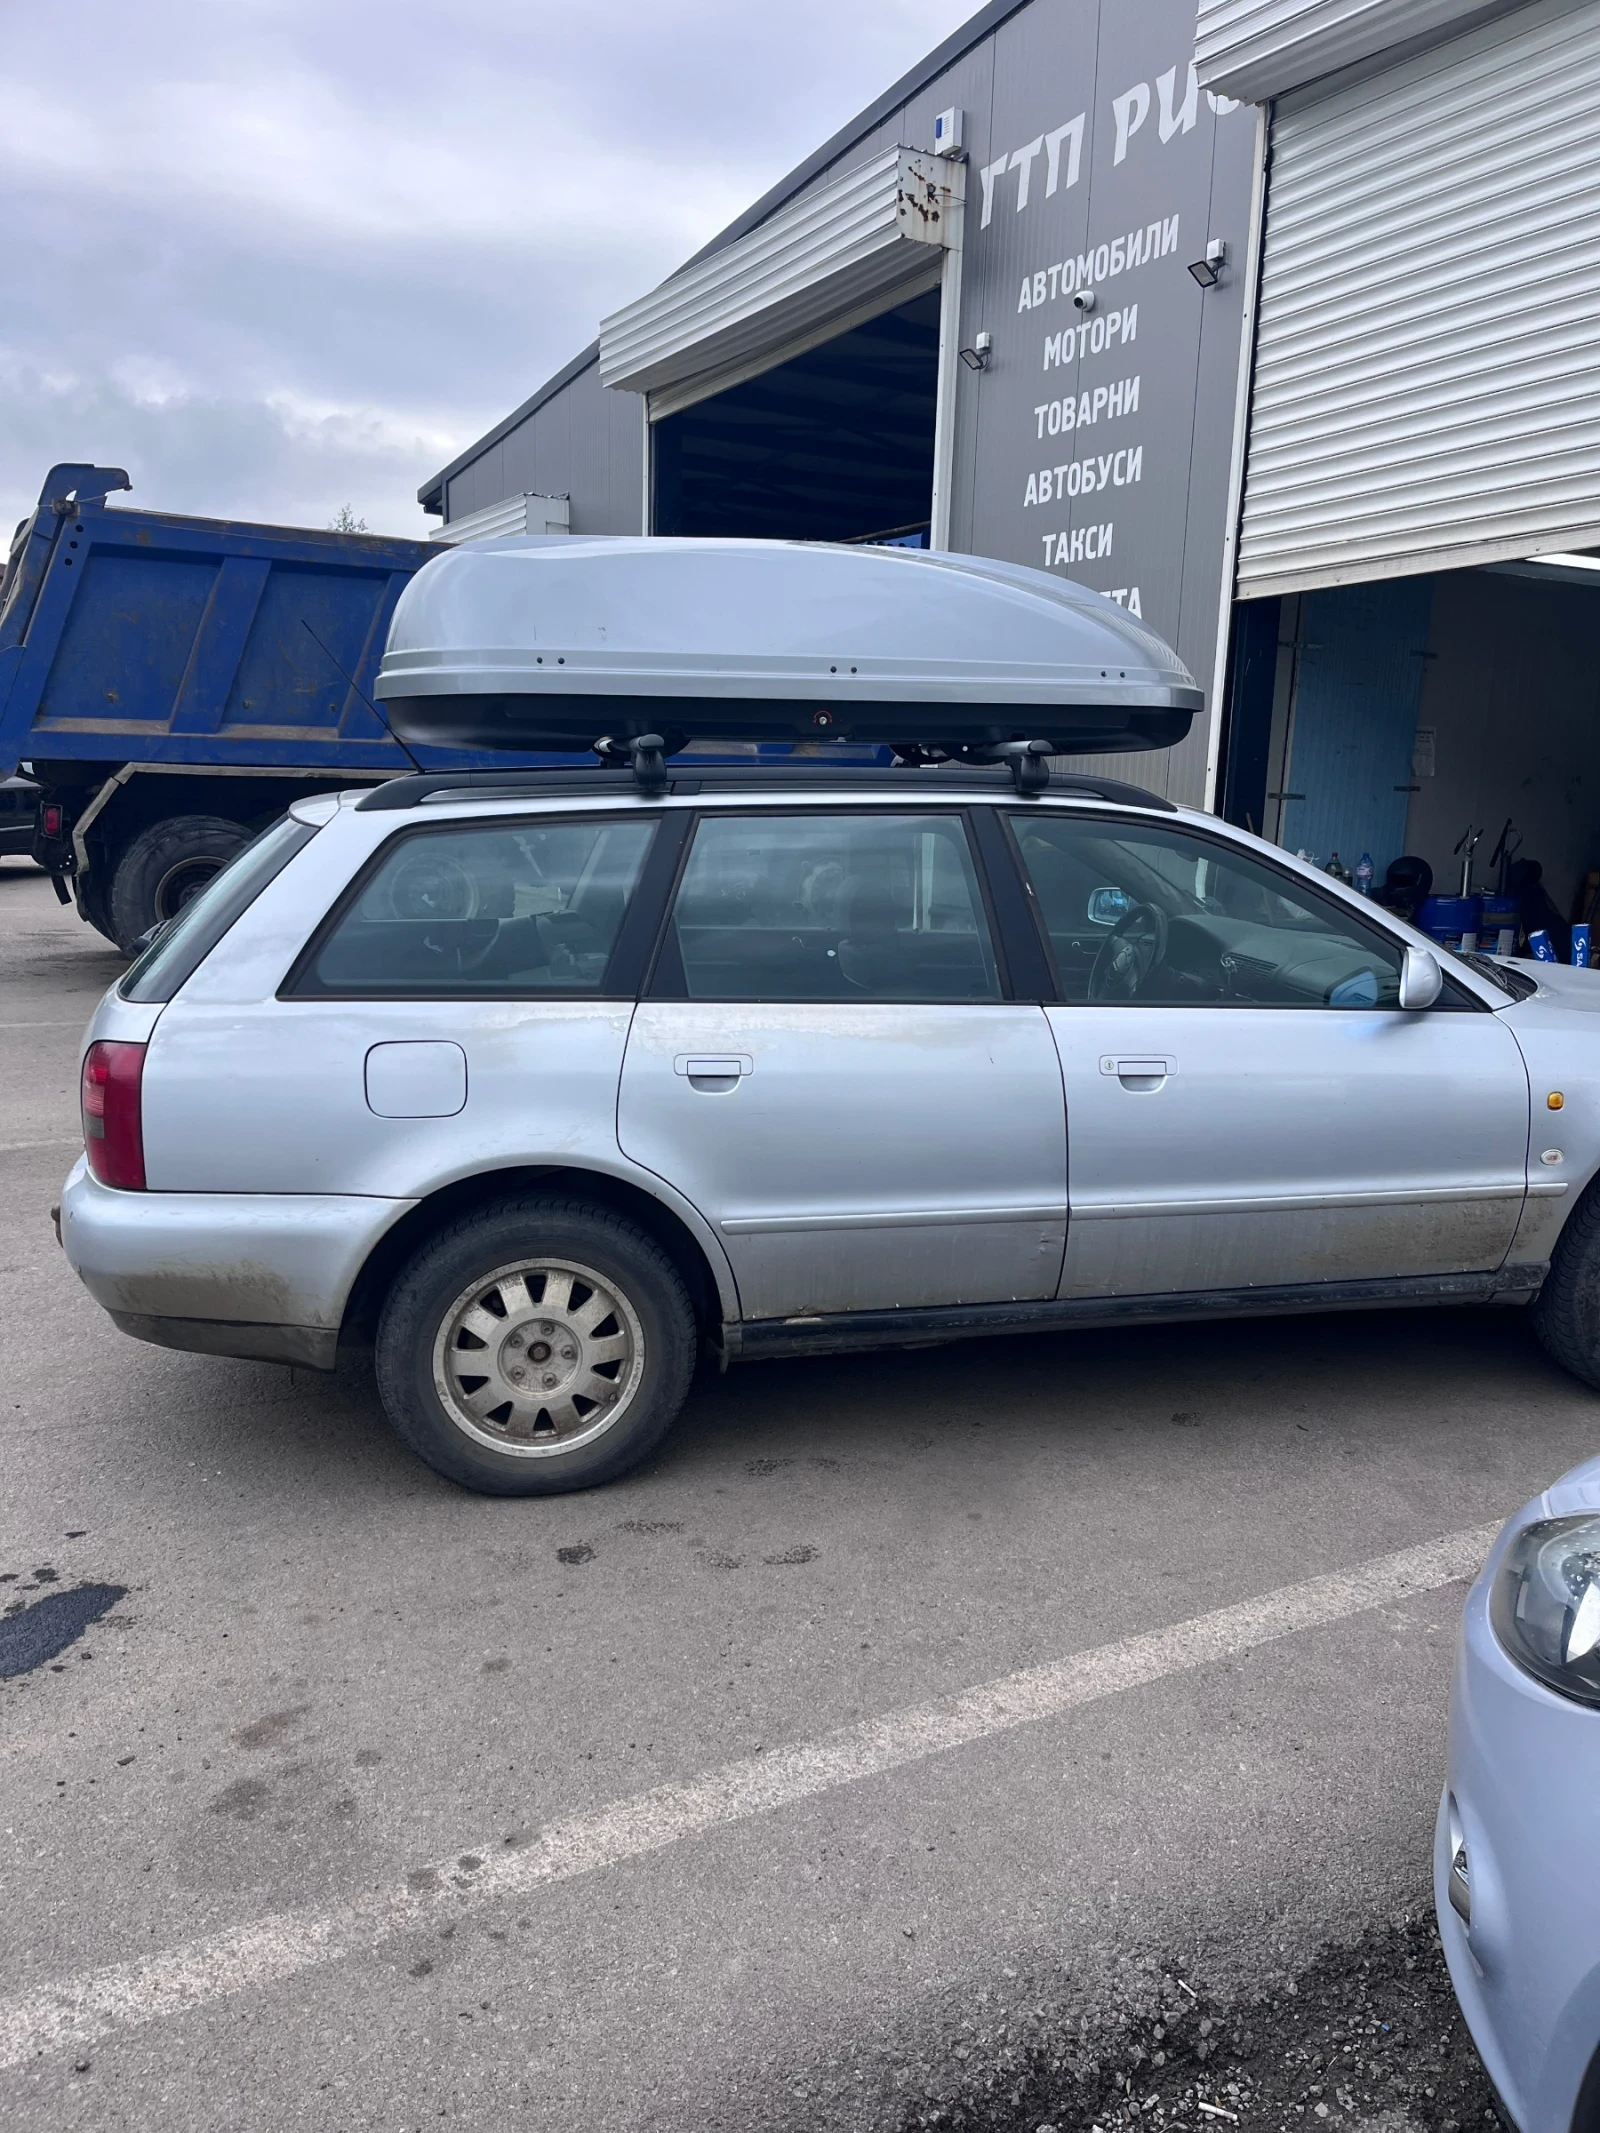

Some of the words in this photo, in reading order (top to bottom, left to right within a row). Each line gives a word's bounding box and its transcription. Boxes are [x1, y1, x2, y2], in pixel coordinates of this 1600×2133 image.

[980, 112, 1086, 230] ГТП
[1017, 213, 1180, 313] АВТОМОБИЛИ
[1043, 303, 1138, 371] МОТОРИ
[1034, 375, 1141, 439] ТОВАРНИ
[1023, 445, 1143, 507] АВТОБУСИ
[1042, 522, 1114, 567] ТАКСИ
